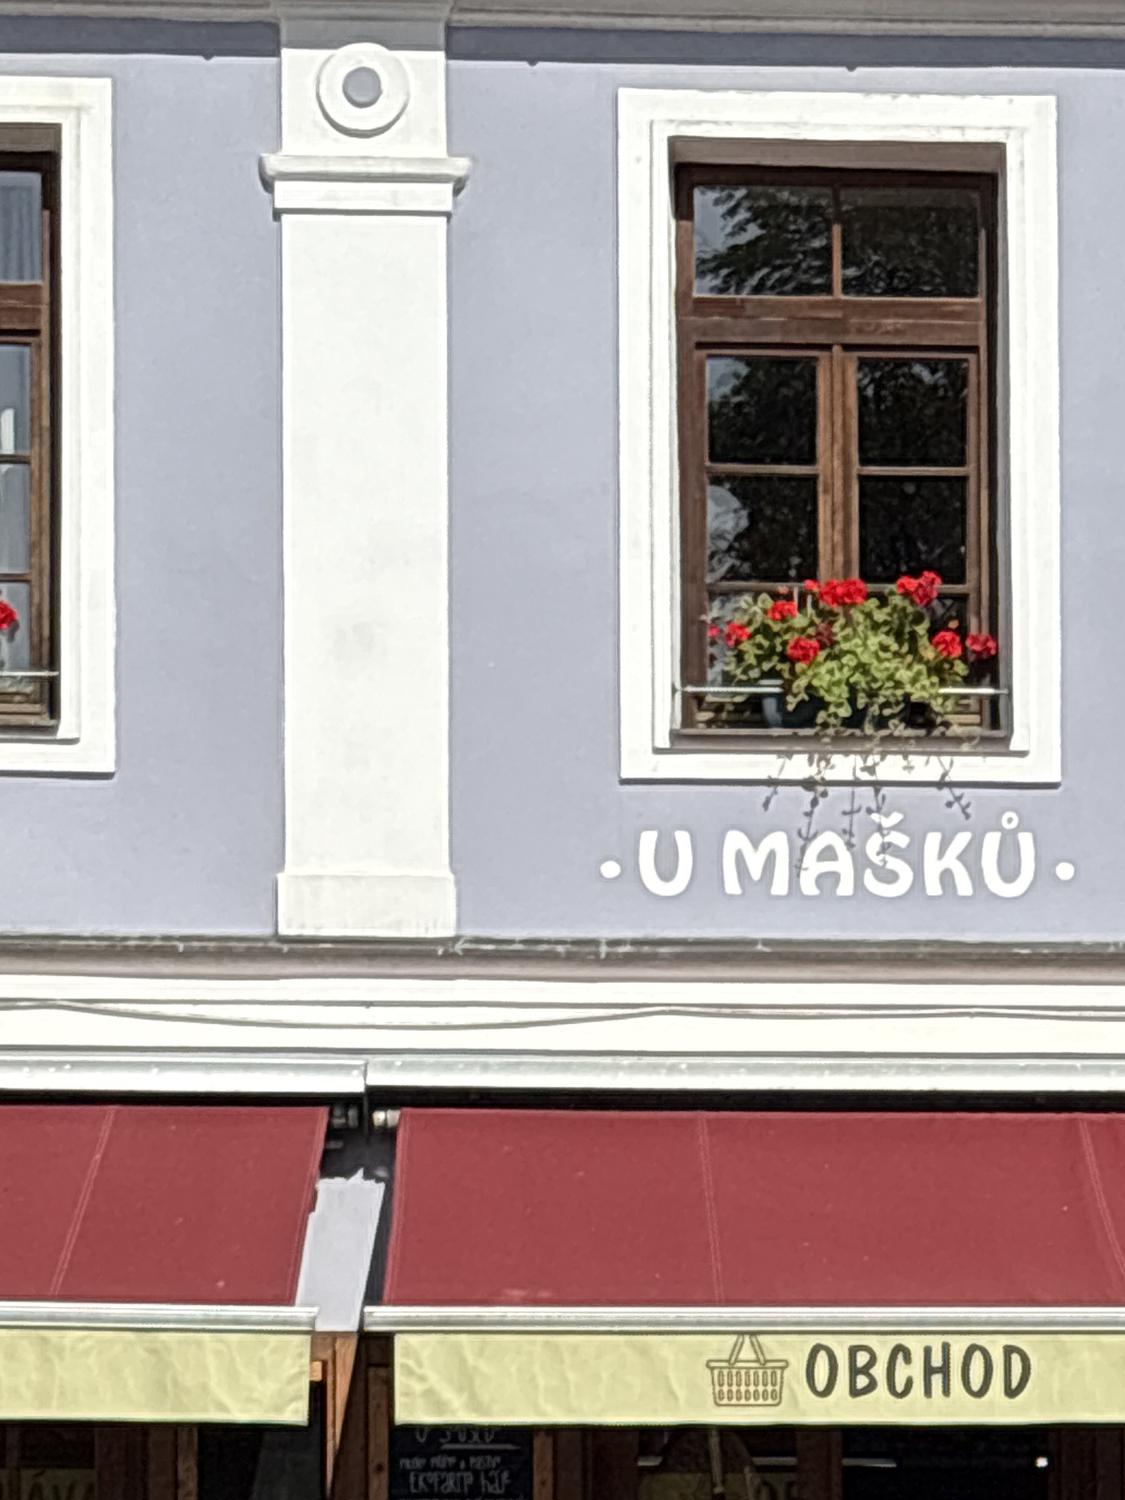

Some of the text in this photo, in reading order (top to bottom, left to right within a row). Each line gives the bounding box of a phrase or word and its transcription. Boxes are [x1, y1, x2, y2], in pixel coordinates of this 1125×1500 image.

[639, 811, 1035, 898] U MAŠKŮ
[805, 1341, 1032, 1400] OBCHOD
